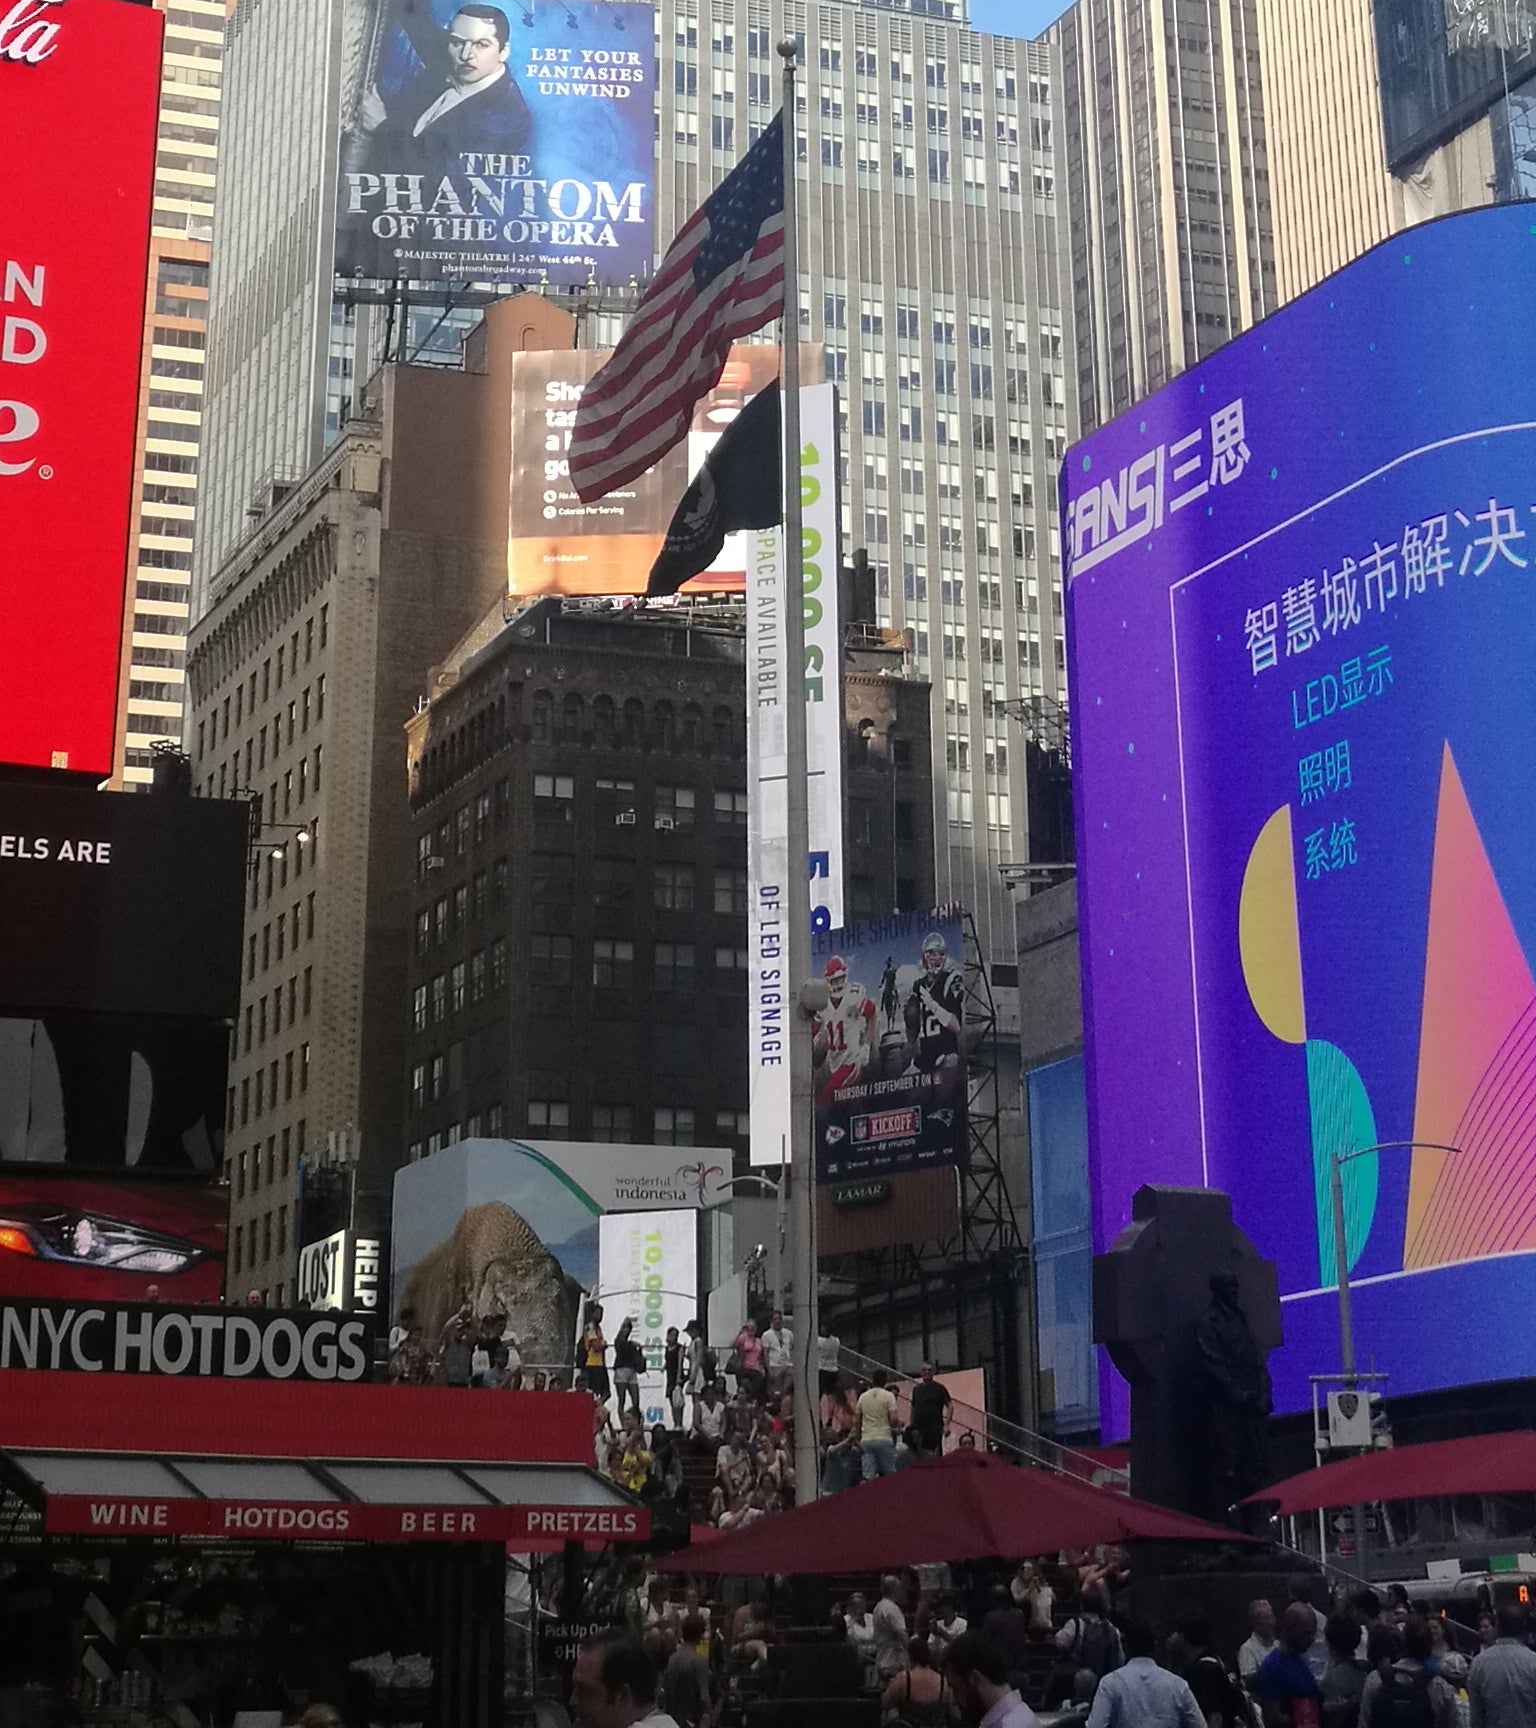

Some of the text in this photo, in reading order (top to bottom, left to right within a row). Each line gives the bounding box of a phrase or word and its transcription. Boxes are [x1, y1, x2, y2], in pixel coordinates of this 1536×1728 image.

[530, 47, 642, 66] LET YOUR
[526, 64, 644, 83] FANTASIES
[539, 81, 631, 99] UNWIND
[459, 152, 532, 177] THE
[344, 172, 646, 224] PHANTOM
[371, 214, 619, 248] OF THE OPERA
[403, 250, 458, 261] MAJESTIC
[459, 252, 510, 262] THEATRE
[518, 254, 535, 263] 247
[1170, 397, 1252, 514] 三思
[757, 597, 778, 708] AVAILABLE
[1297, 739, 1354, 807] 照明
[56, 838, 112, 865] ARE
[1303, 817, 1360, 880] 系统
[840, 925, 866, 950] THE
[869, 915, 912, 942] SHOW
[759, 885, 782, 1067] OF LED SIGNAGE
[833, 1086, 867, 1101] THURSDAY
[874, 1078, 913, 1095] SEPTEMBER
[921, 1074, 932, 1087] ON
[872, 1113, 912, 1135] KICKOFF
[616, 1176, 670, 1187] wonderful
[616, 1186, 687, 1201] indonesia
[836, 1183, 883, 1202] LAMAR
[302, 1240, 339, 1303] LOST
[0, 1306, 367, 1382] NYC HOTDOGS
[90, 1503, 637, 1534] WINE HOTDOGS BEER PRETZELS
[545, 1623, 587, 1639] Pick Up
